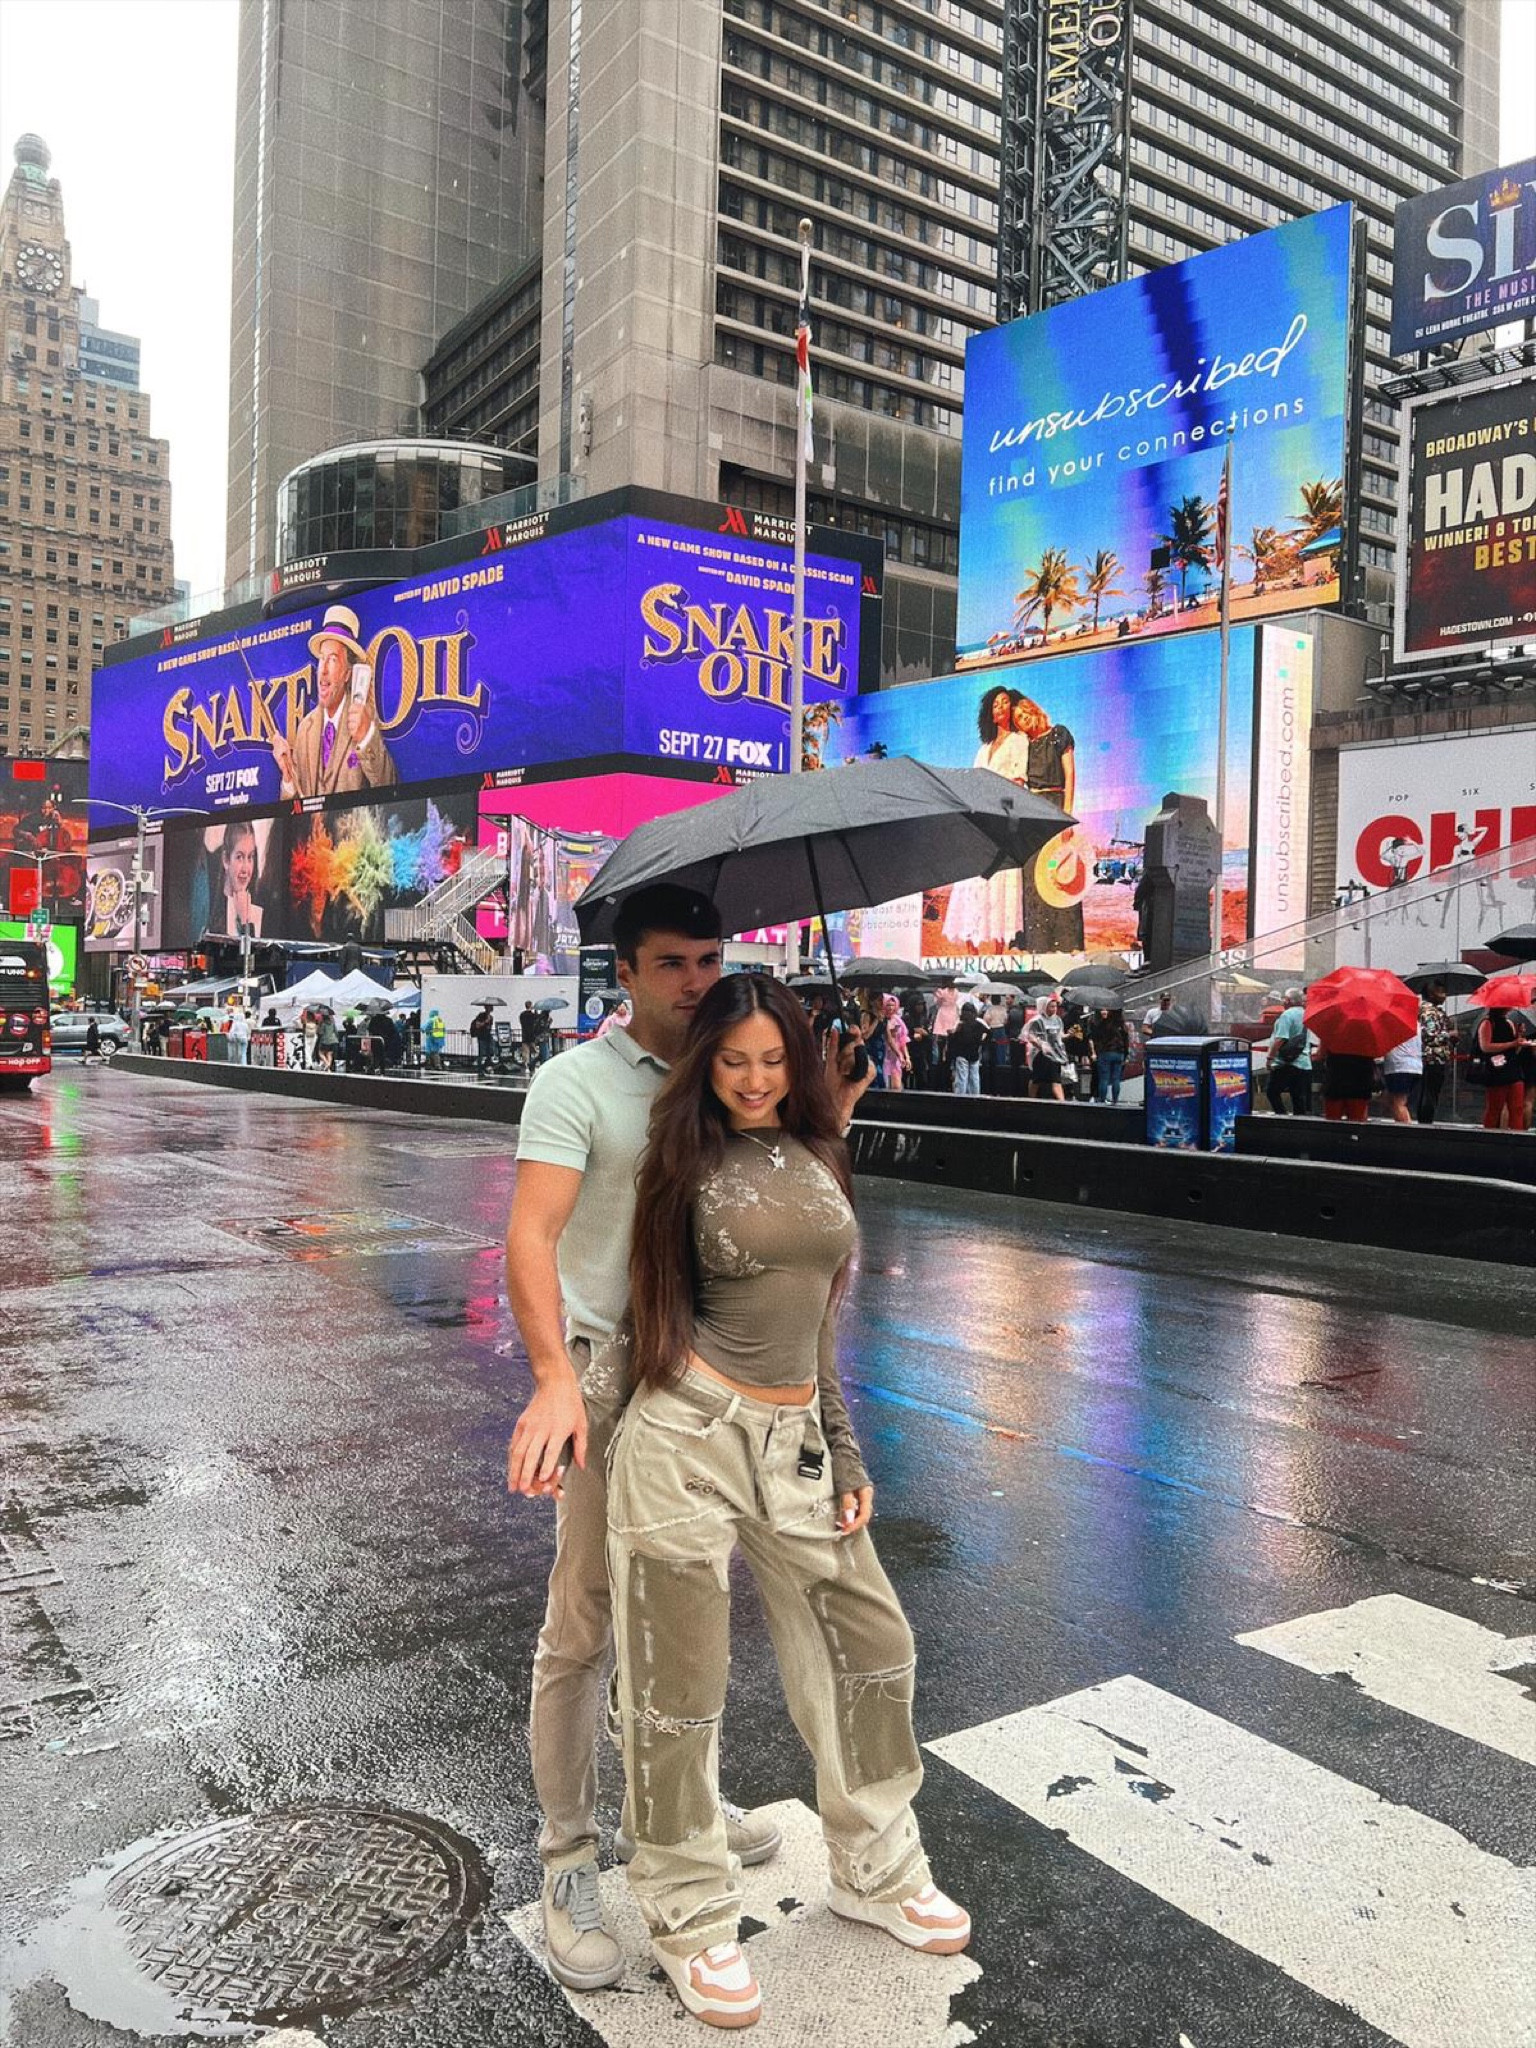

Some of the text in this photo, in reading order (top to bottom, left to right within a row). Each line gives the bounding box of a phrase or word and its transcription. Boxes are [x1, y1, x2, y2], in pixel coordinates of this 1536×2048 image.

[1425, 181, 1536, 302] SI
[1465, 289, 1491, 310] THE
[988, 313, 1307, 453] unsubscribed
[988, 396, 1304, 496] find your connections
[1425, 418, 1528, 458] BROADWAY'S
[1424, 453, 1536, 532] HAD
[505, 526, 544, 545] MARQUIS
[506, 511, 550, 533] MARRIOTT
[754, 513, 814, 536] MARRIOT
[1424, 524, 1489, 551] WINNER!
[283, 557, 329, 575] MARRIOTT
[637, 533, 646, 544] A
[647, 536, 670, 550] NEW
[672, 537, 701, 555] GAME
[702, 547, 732, 561] SHOW
[733, 553, 765, 568] BASED
[766, 558, 779, 571] ON
[780, 562, 788, 573] A
[828, 571, 854, 586] SCAM
[1474, 535, 1536, 571] BEST
[283, 570, 321, 587] MARQUIS
[422, 577, 460, 603] DAVID
[461, 564, 504, 591] SPADE
[726, 571, 761, 588] DAVID
[259, 626, 289, 643] CLASSIC
[290, 619, 312, 636] SCAM
[366, 624, 482, 732] OIL
[659, 729, 772, 767] SEPT 27 FOX
[205, 766, 260, 794] SEPT 27 FOX
[1461, 788, 1479, 797] SIX
[1277, 686, 1295, 913] unsubscribed.com
[1388, 793, 1409, 802] POP
